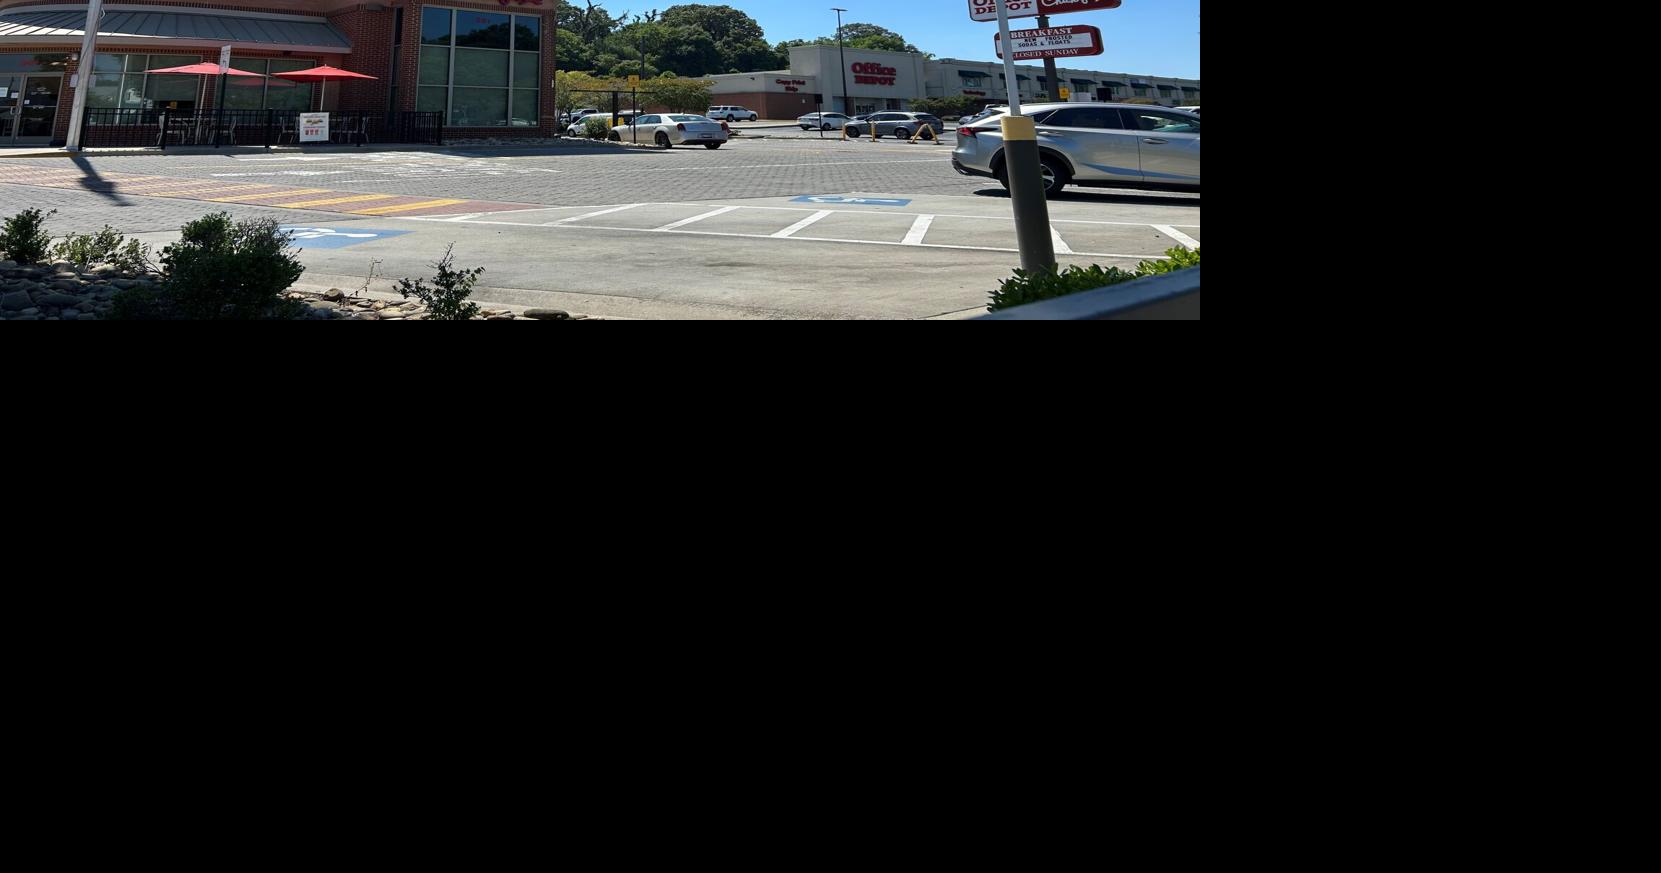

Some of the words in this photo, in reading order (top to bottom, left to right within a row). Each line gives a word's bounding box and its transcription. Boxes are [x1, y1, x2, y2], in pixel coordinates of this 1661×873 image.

[975, 1, 1032, 14] DEOT
[1011, 27, 1073, 39] BREAKFAST
[1044, 48, 1079, 56] SUNDAY
[851, 62, 897, 76] Office
[854, 75, 896, 86] DEPOT
